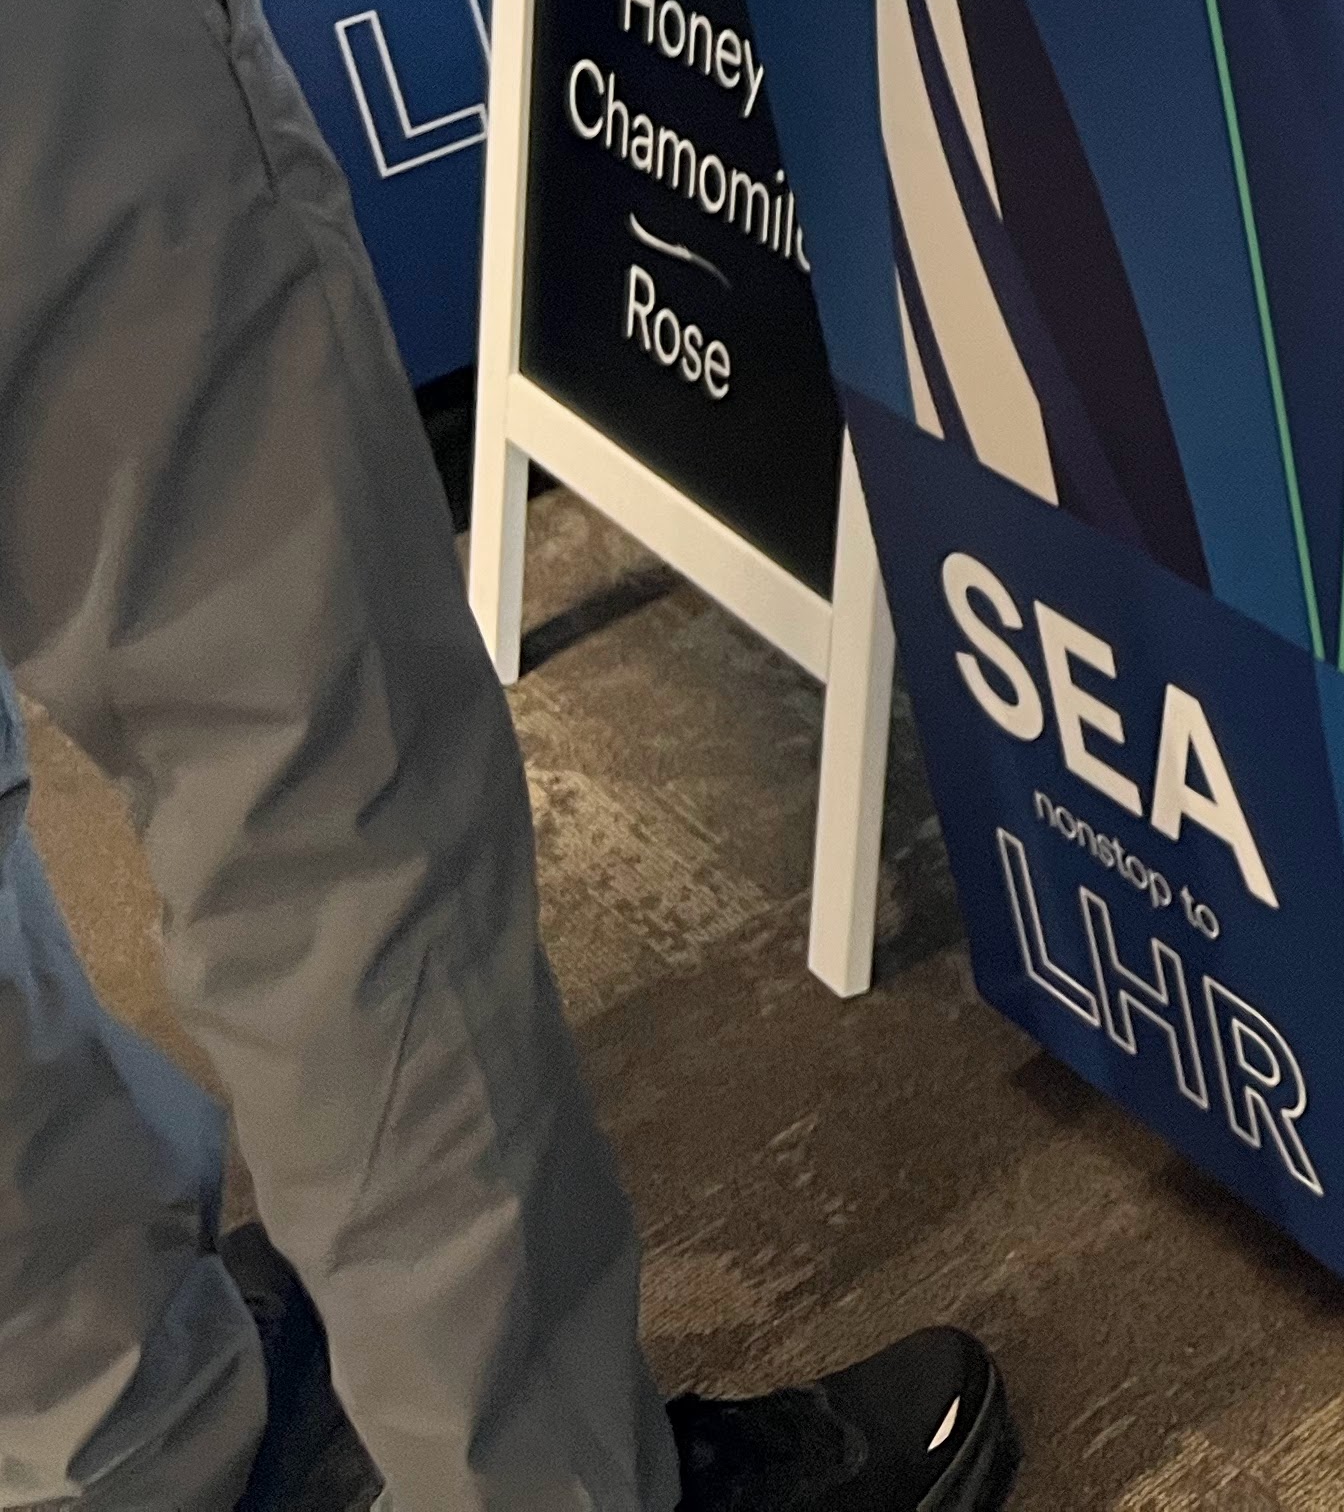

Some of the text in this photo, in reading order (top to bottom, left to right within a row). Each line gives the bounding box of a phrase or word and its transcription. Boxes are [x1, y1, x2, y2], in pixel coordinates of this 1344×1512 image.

[625, 264, 732, 399] Rose
[942, 552, 1279, 909] SEA
[1034, 790, 1220, 940] nonstop to
[997, 827, 1323, 1196] LHR
